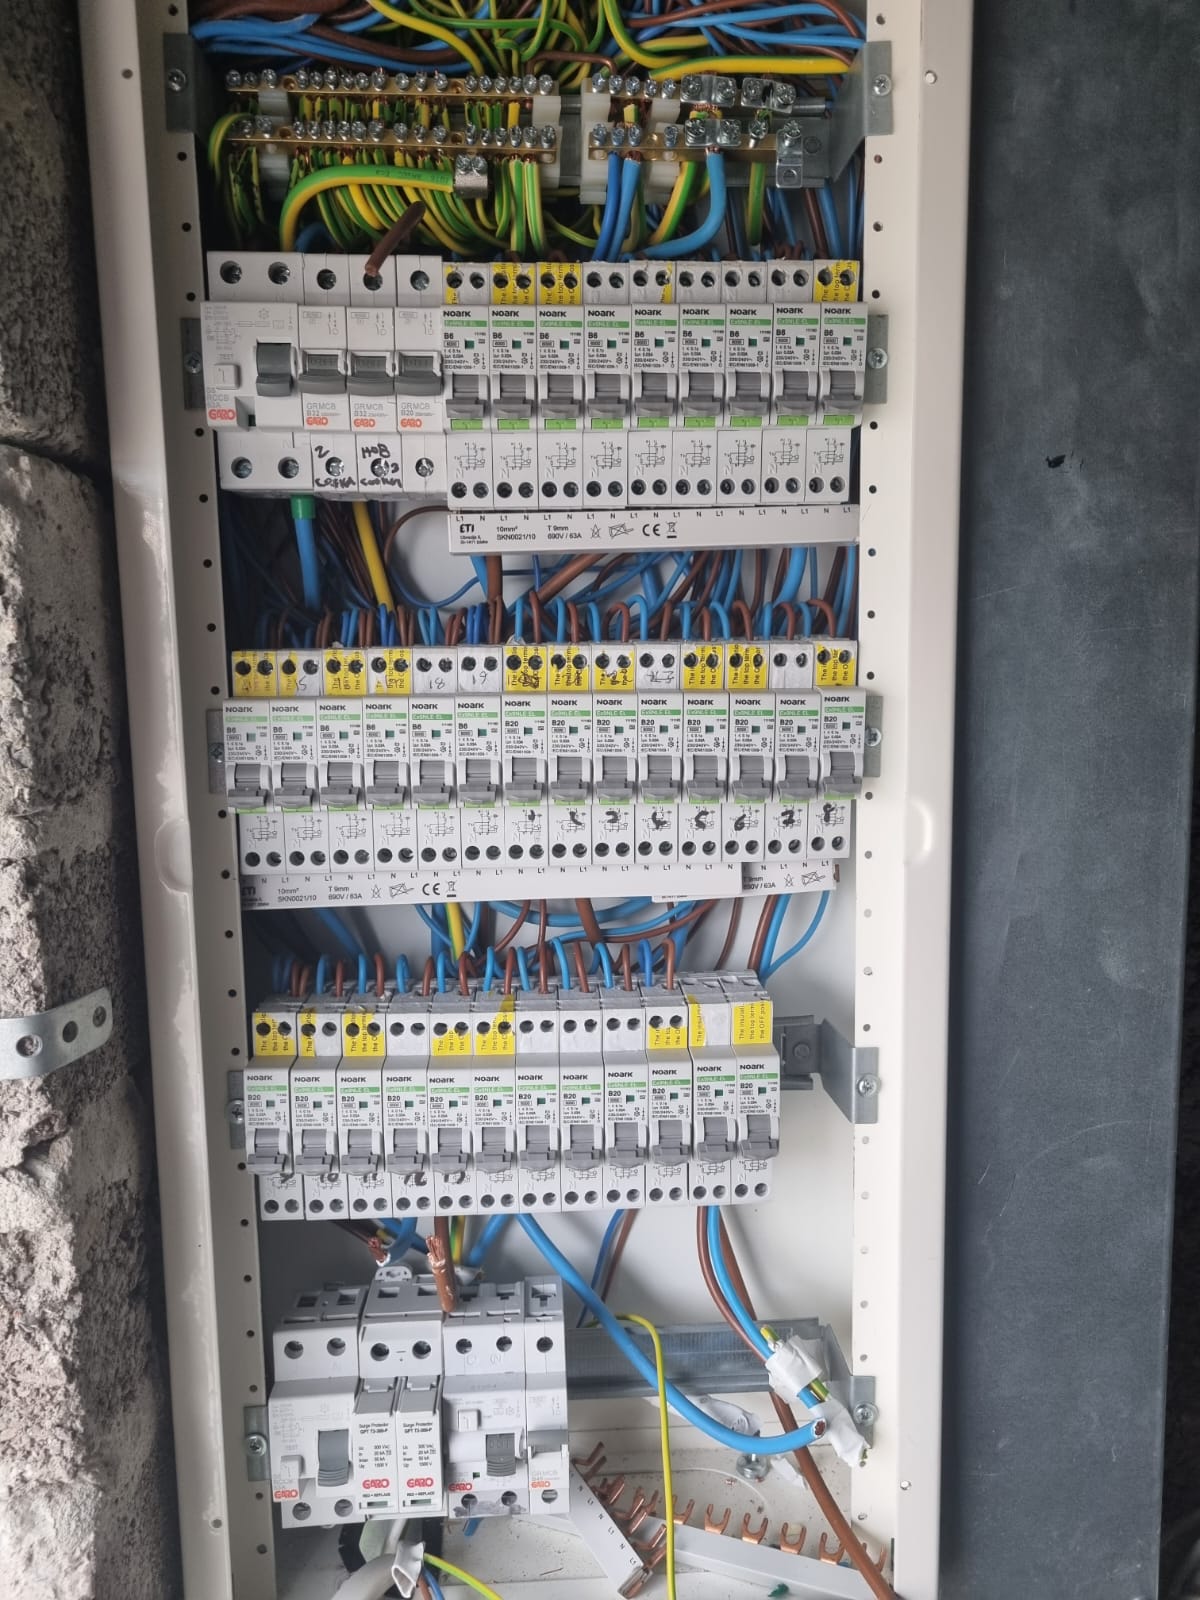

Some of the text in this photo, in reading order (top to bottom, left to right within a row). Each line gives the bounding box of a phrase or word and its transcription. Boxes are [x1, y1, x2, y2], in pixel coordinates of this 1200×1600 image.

[209, 409, 236, 420] GARO
[306, 417, 328, 425] GARO
[354, 419, 375, 427] GARO
[401, 419, 422, 427] GARO
[460, 524, 474, 533] ETI
[734, 814, 746, 831] 6
[363, 1479, 389, 1489] GARO
[407, 1478, 433, 1488] GARO
[448, 1483, 472, 1491] GARO
[274, 1489, 298, 1499] GARO
